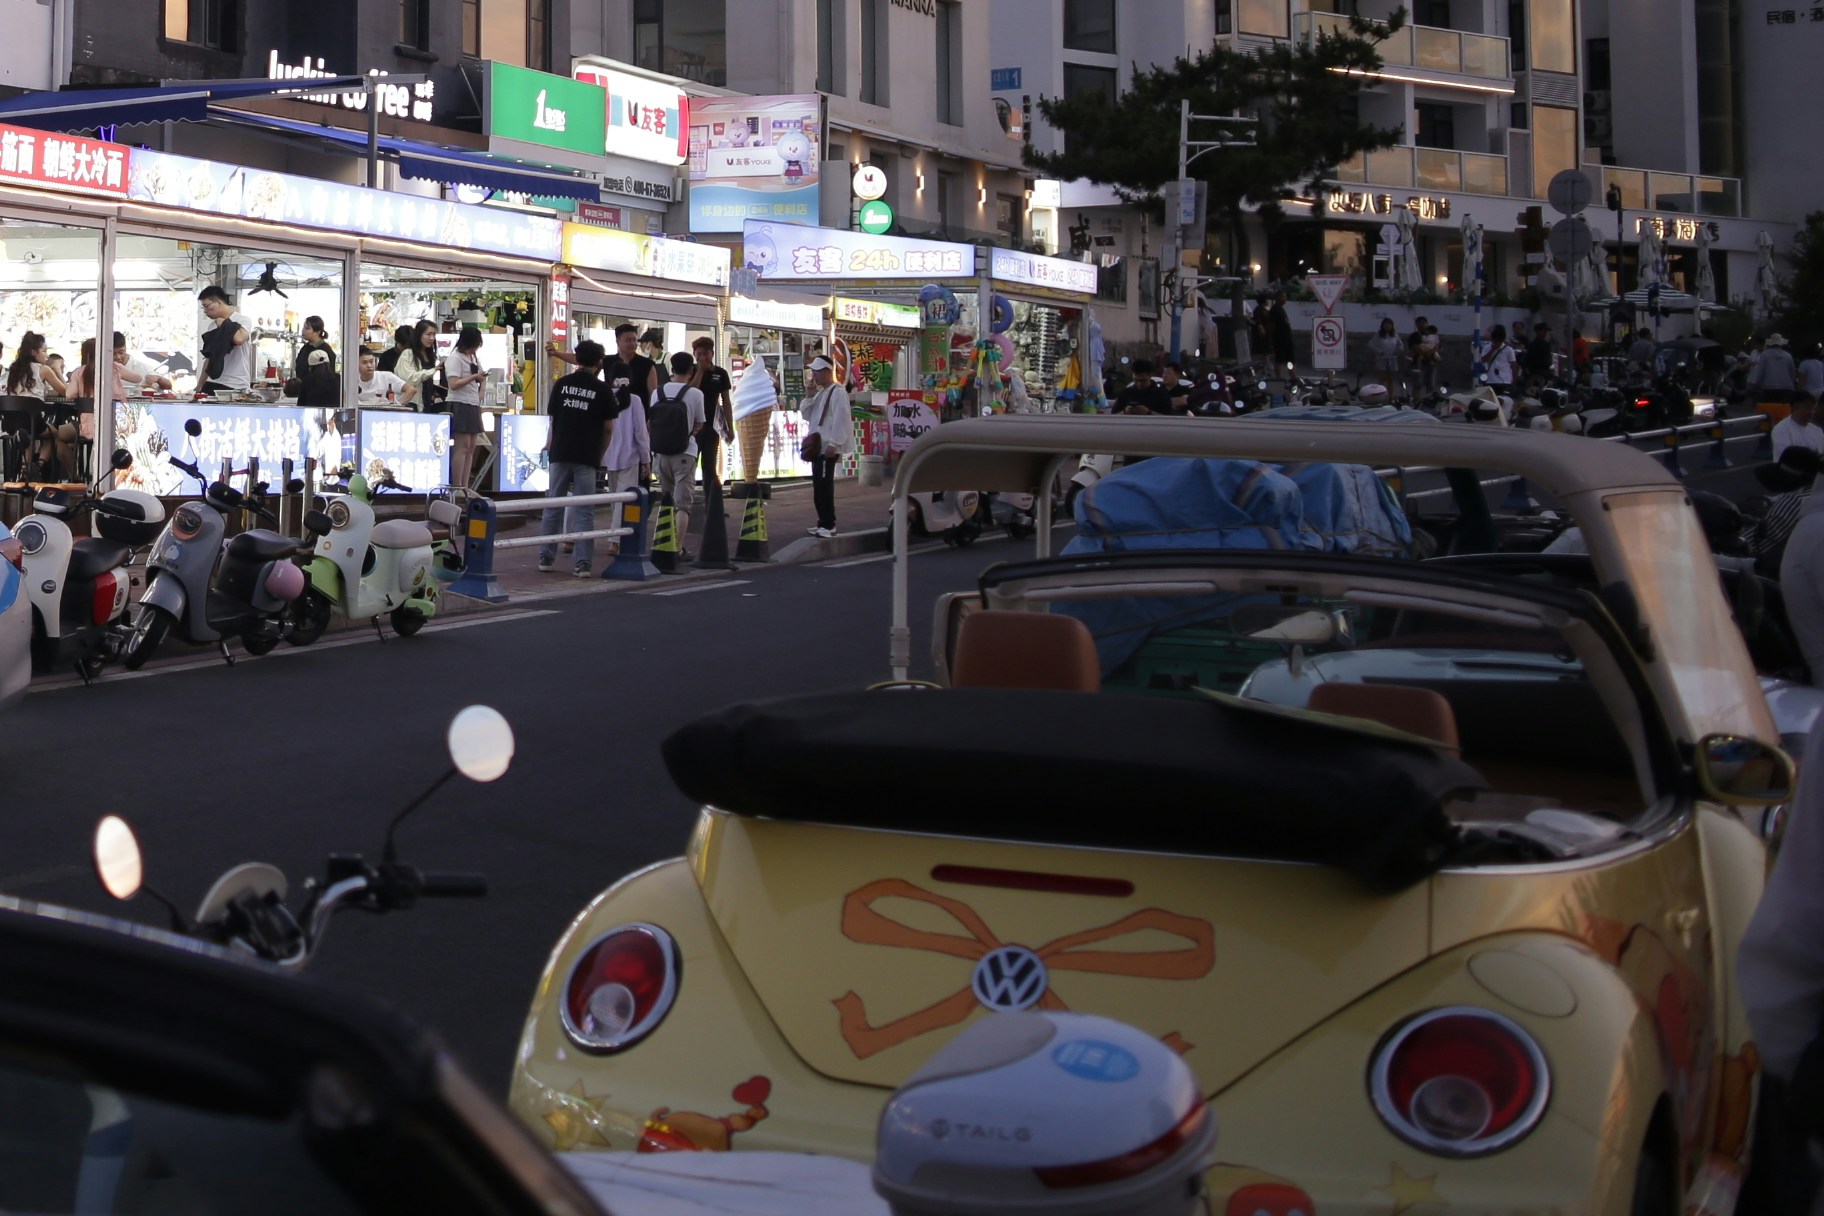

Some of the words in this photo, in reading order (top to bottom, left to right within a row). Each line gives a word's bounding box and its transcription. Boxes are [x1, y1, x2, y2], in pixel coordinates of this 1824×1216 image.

[641, 104, 666, 135] 友客
[43, 137, 124, 188] 朝鲜大冷面
[736, 157, 750, 166] 友客
[750, 158, 773, 166] YOUKE
[773, 204, 808, 216] 便利店
[792, 245, 844, 274] 友客
[849, 249, 900, 271] 24h
[904, 250, 962, 273] 便利店
[561, 385, 597, 399] 八街活鲜
